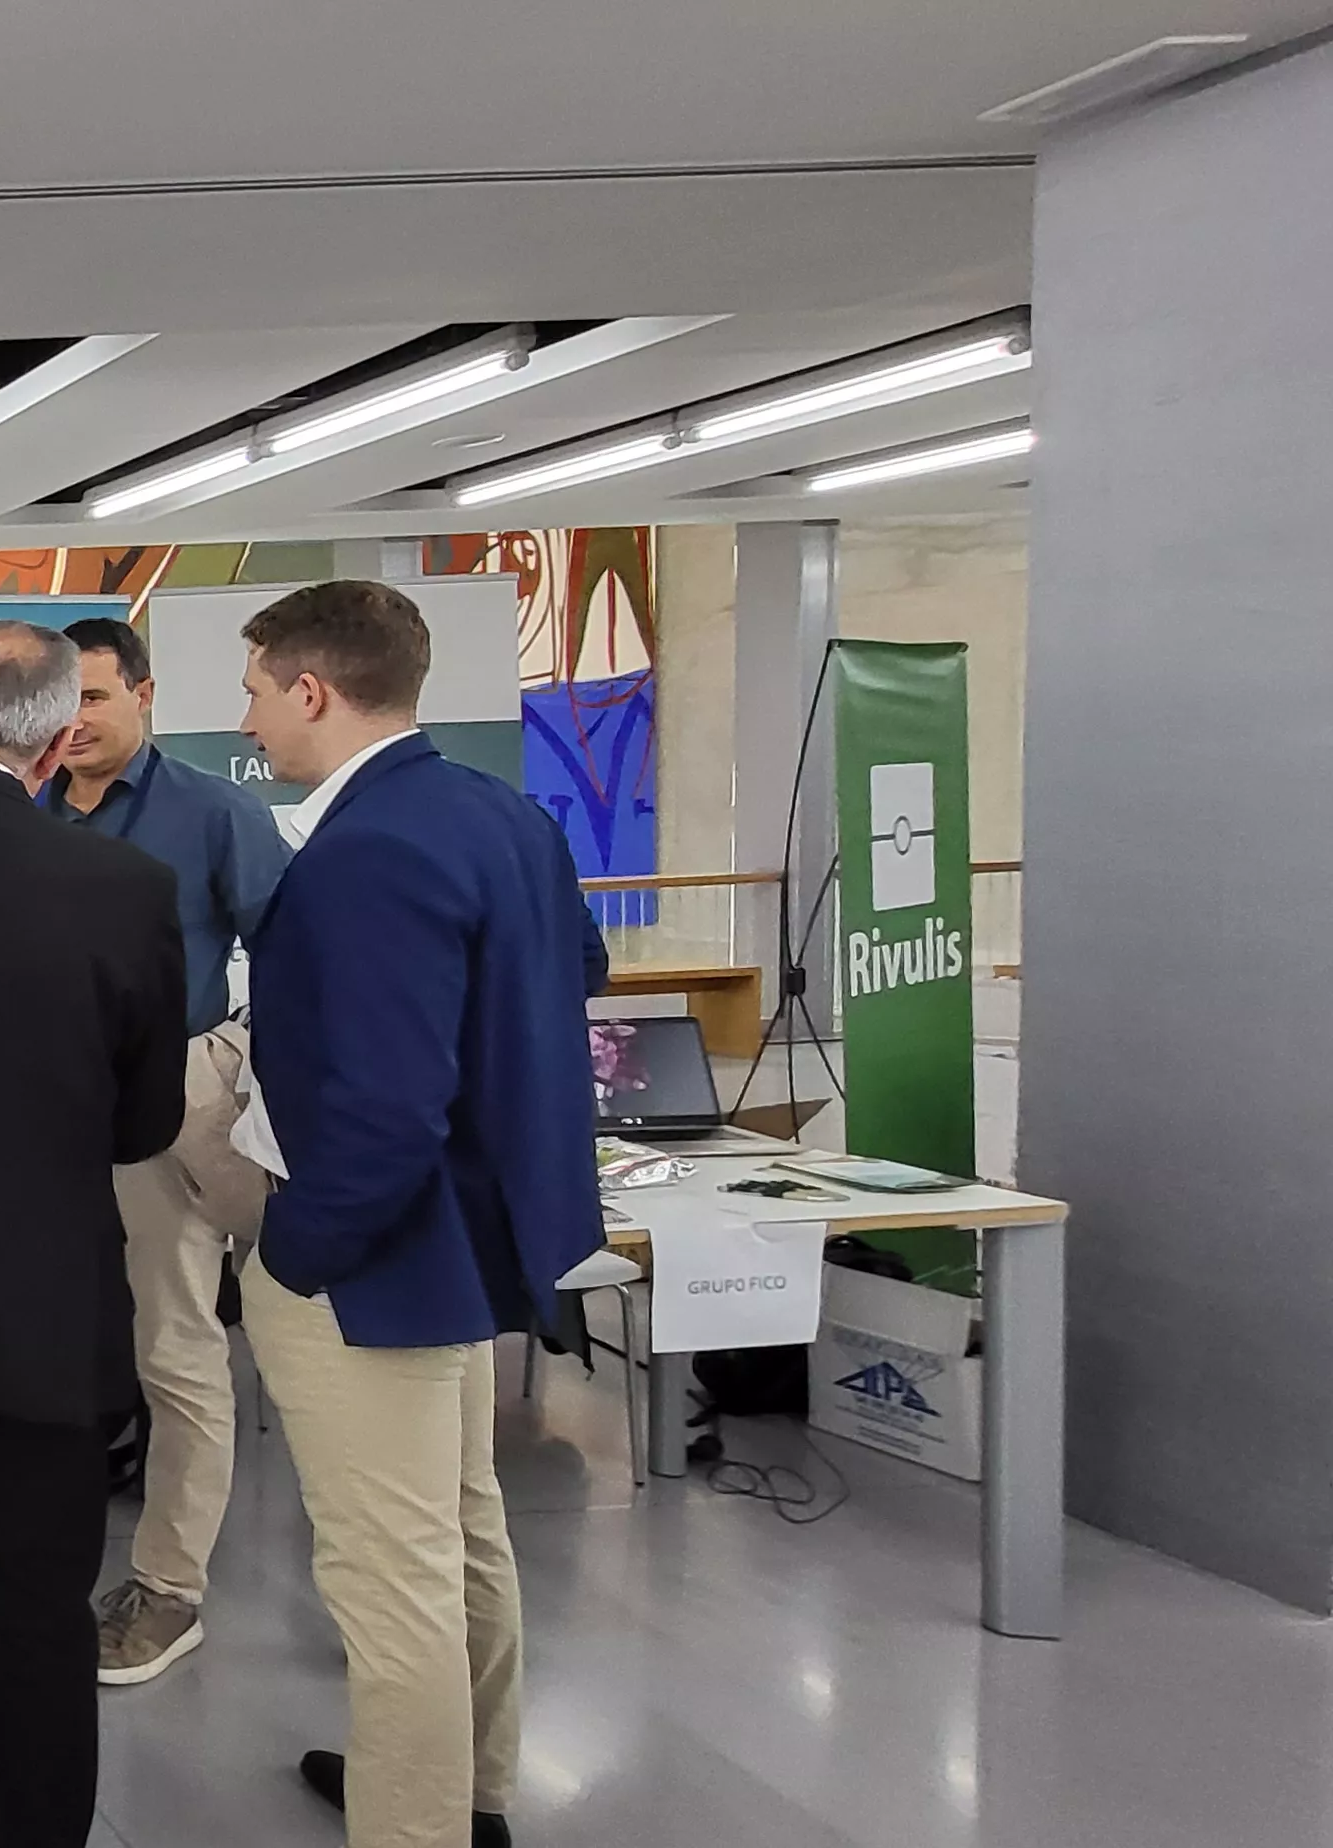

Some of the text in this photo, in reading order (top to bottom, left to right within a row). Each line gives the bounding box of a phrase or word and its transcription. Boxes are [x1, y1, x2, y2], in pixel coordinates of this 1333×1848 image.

[849, 917, 963, 998] Rivulis
[687, 1275, 787, 1295] GRUPO FICO
